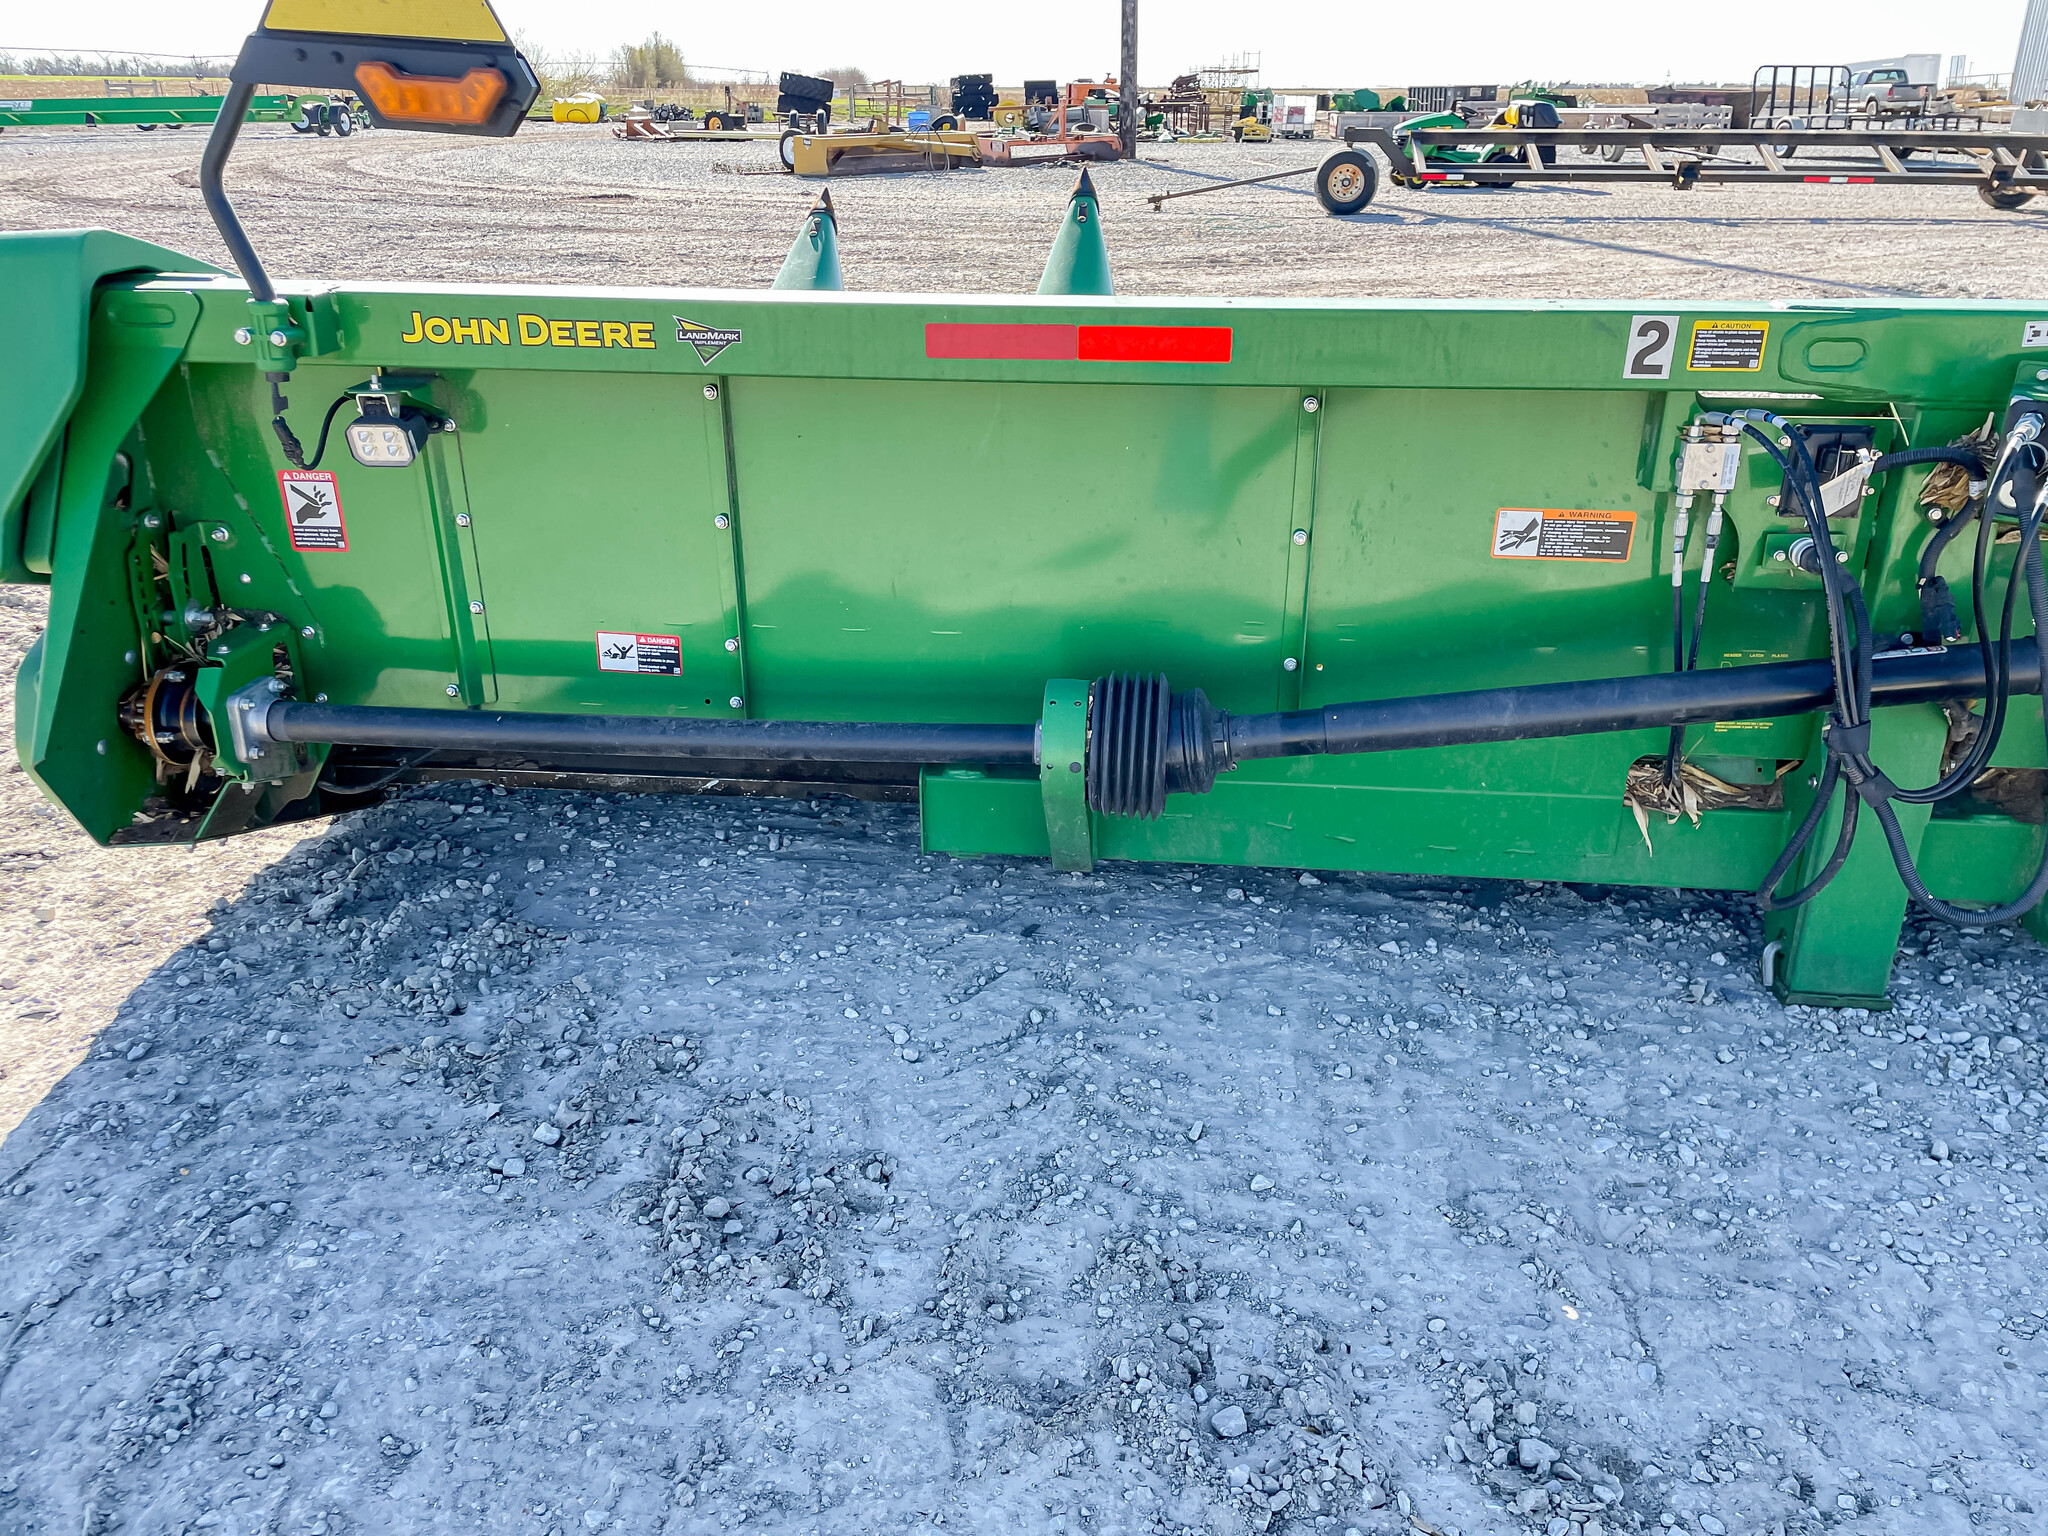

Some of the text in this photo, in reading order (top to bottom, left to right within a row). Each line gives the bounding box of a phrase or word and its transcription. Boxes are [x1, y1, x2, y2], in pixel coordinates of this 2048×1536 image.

[401, 310, 657, 350] JOHN DEERE
[693, 339, 728, 347] IMPLEMENT
[1630, 320, 1670, 374] 2
[292, 472, 332, 480] DANGER
[1569, 511, 1612, 519] WARNING
[647, 637, 676, 645] DANGER
